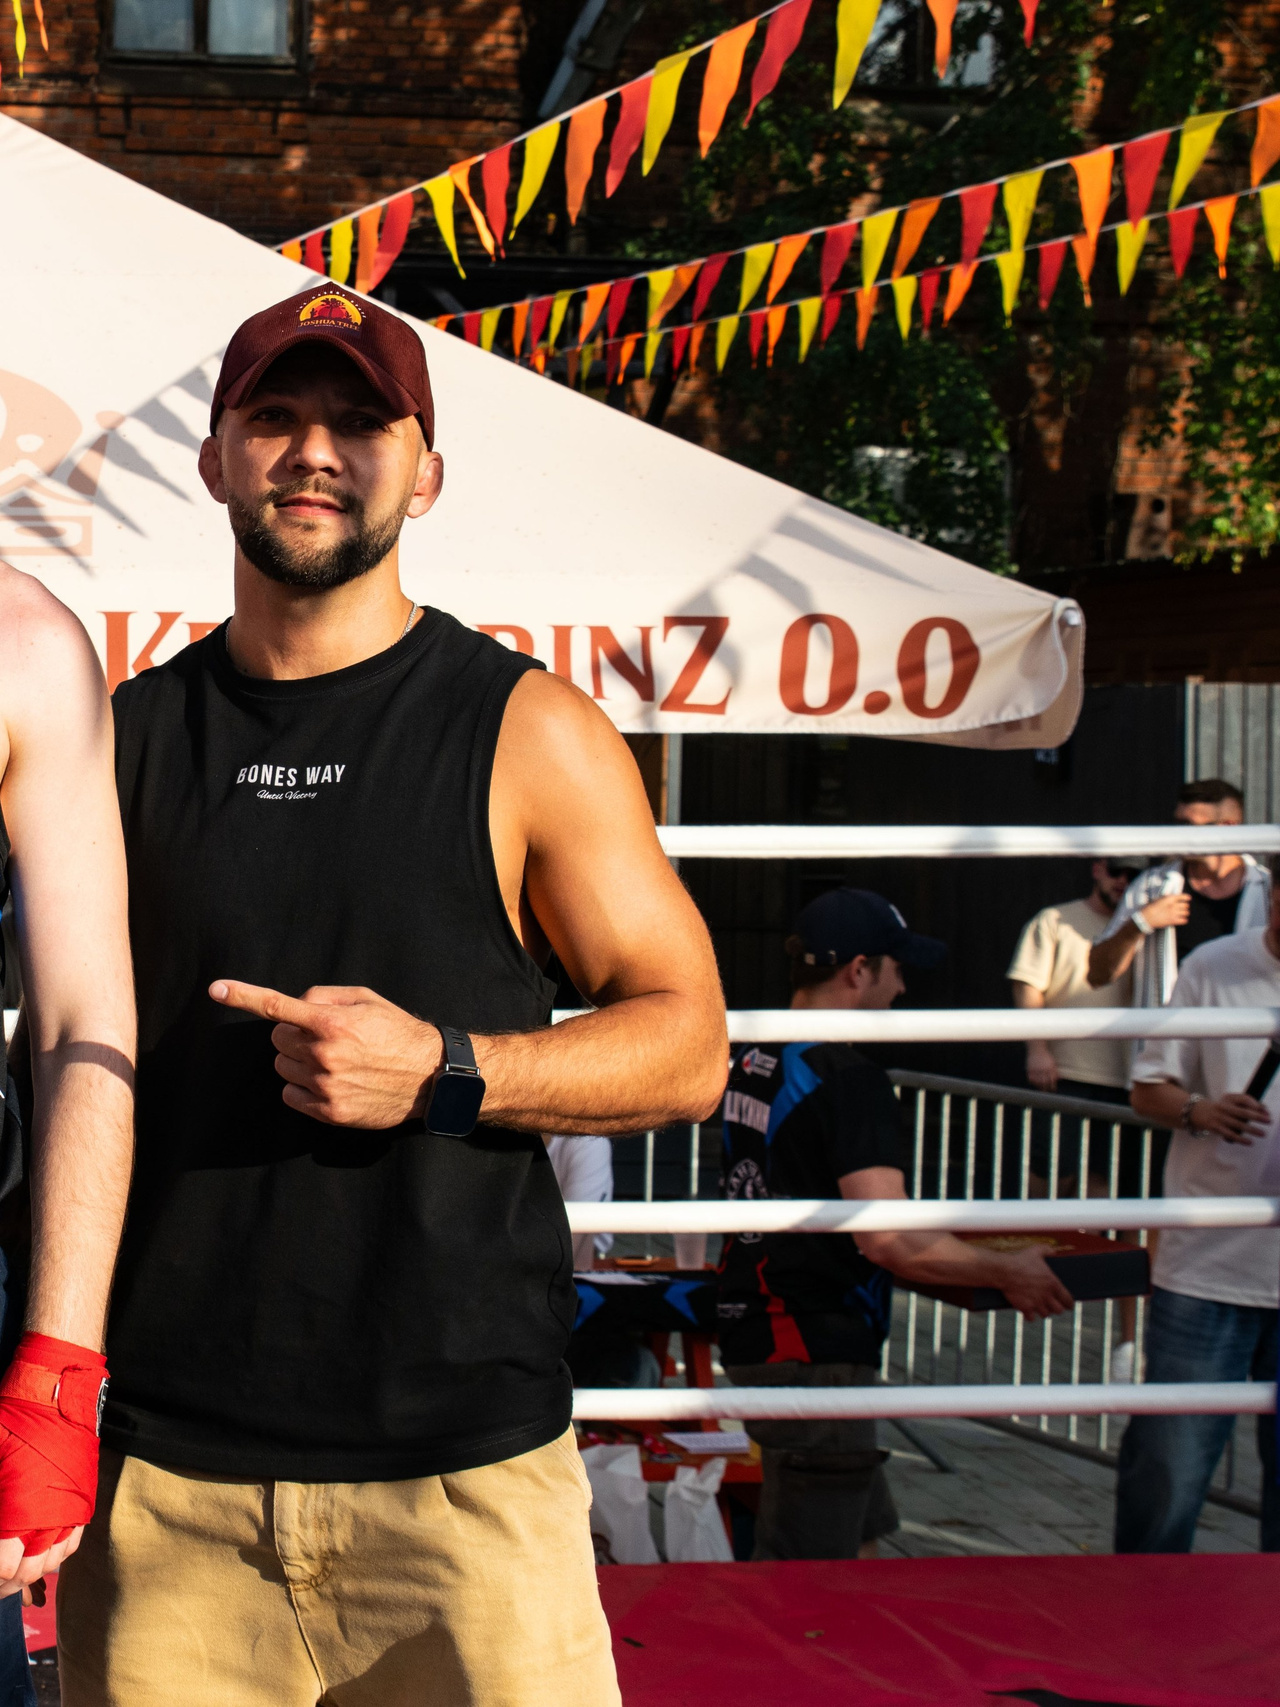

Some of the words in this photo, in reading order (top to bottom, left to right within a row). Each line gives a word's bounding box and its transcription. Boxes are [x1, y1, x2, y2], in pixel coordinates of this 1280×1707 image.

[778, 613, 982, 719] 0.0
[236, 763, 298, 787] BONES
[306, 764, 346, 786] WAY
[256, 789, 284, 800] Until
[285, 789, 317, 800] Victory
